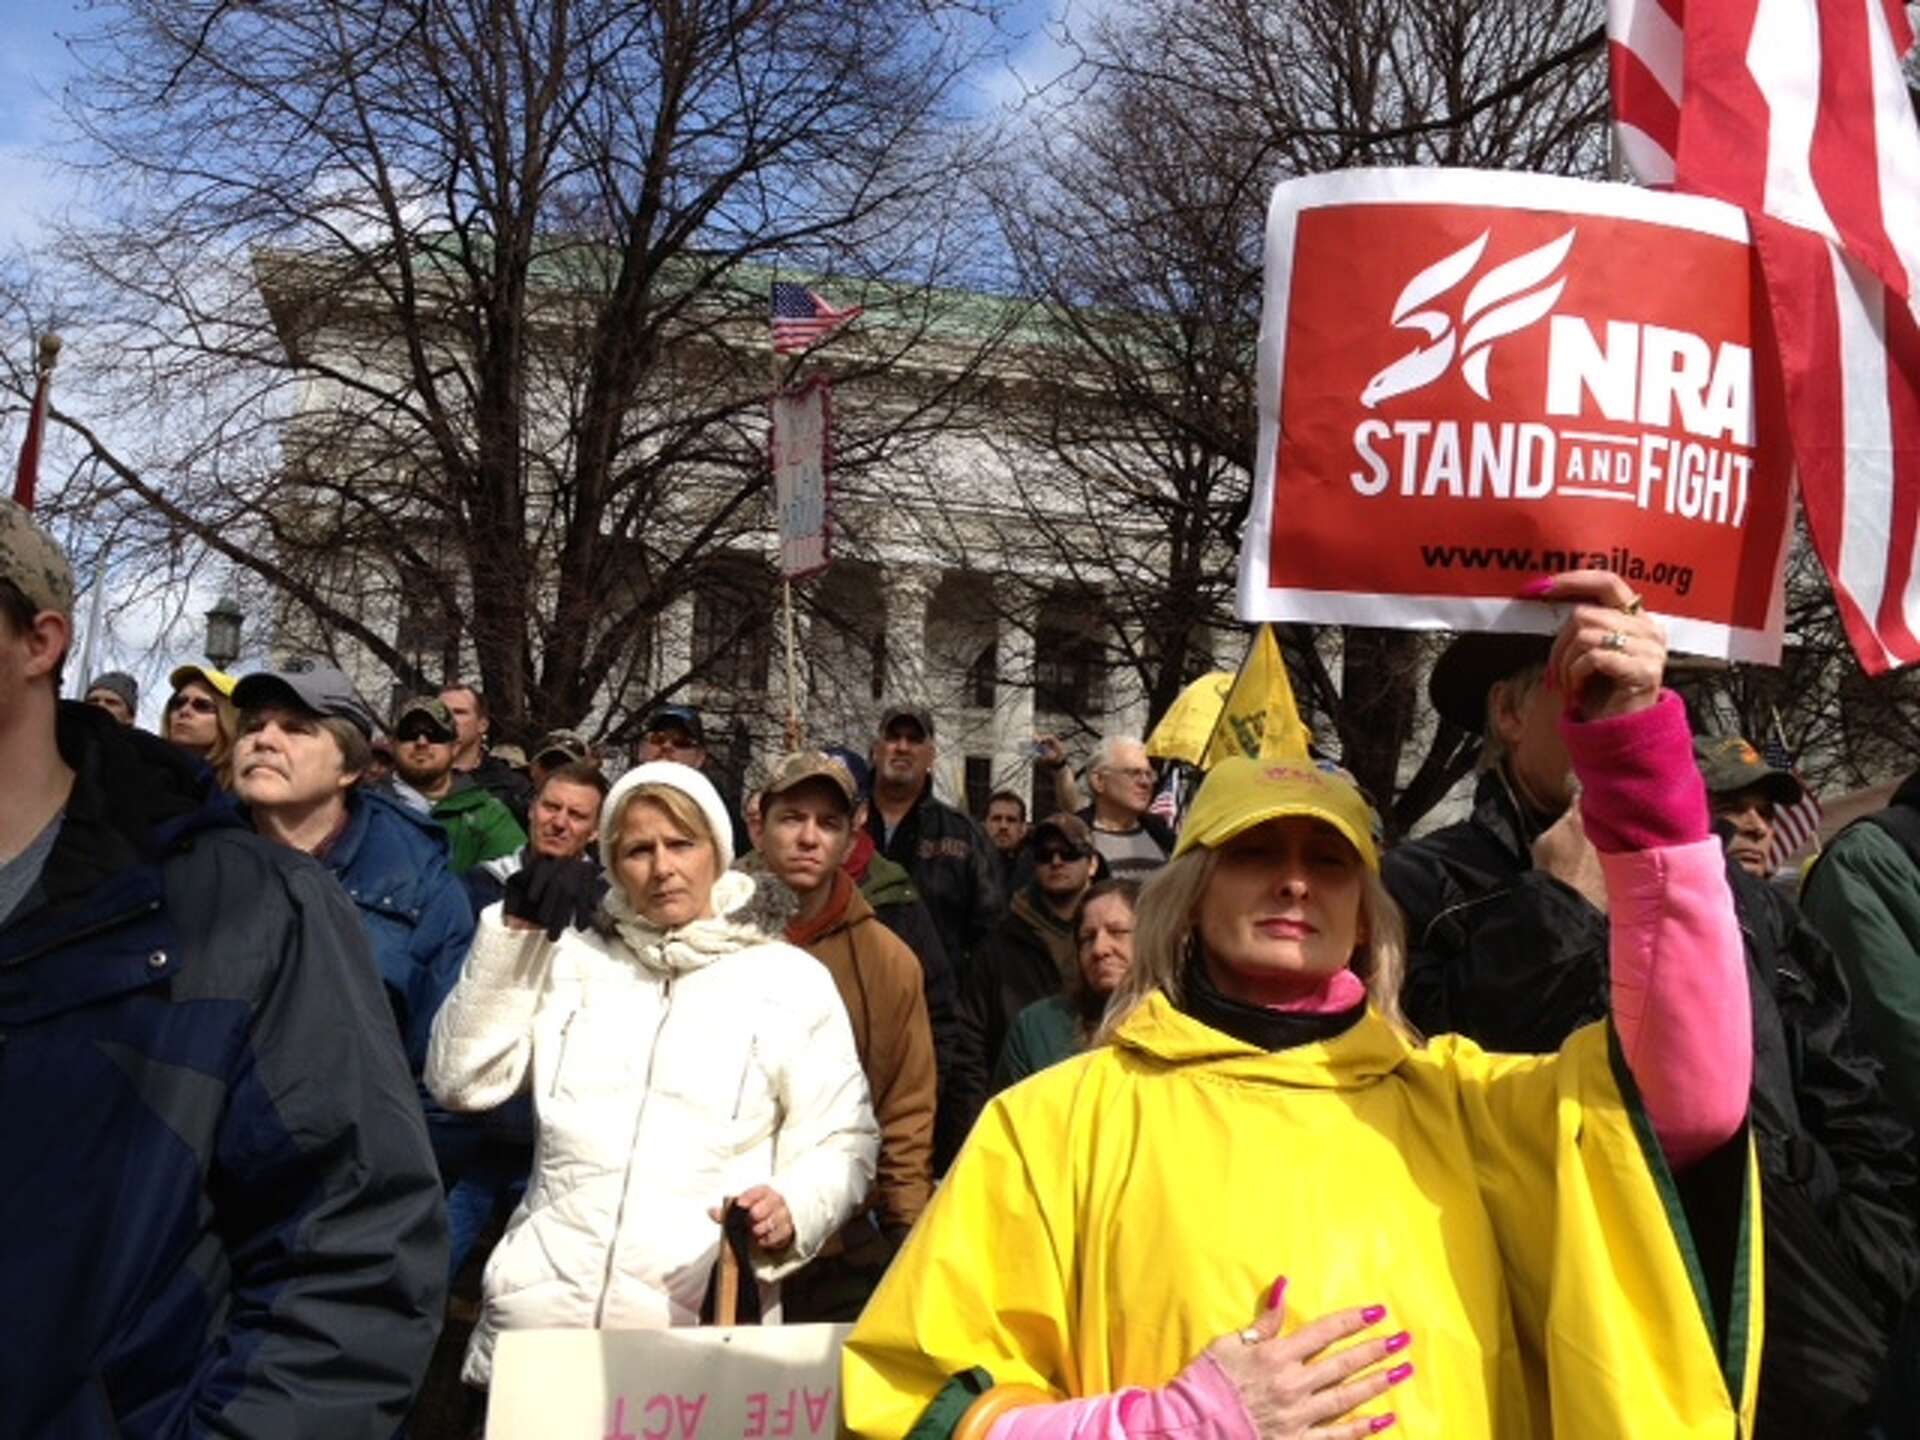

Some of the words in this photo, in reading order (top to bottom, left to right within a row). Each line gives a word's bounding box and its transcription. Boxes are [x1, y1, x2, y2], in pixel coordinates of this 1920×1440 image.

[1546, 315, 1755, 447] NRA
[1349, 419, 1557, 499] STAND
[1566, 446, 1632, 484] AND
[1637, 432, 1754, 528] FIGHT
[1421, 544, 1694, 595] www.nraila.org
[603, 1393, 708, 1440] ACT
[744, 1387, 833, 1438] AFE
